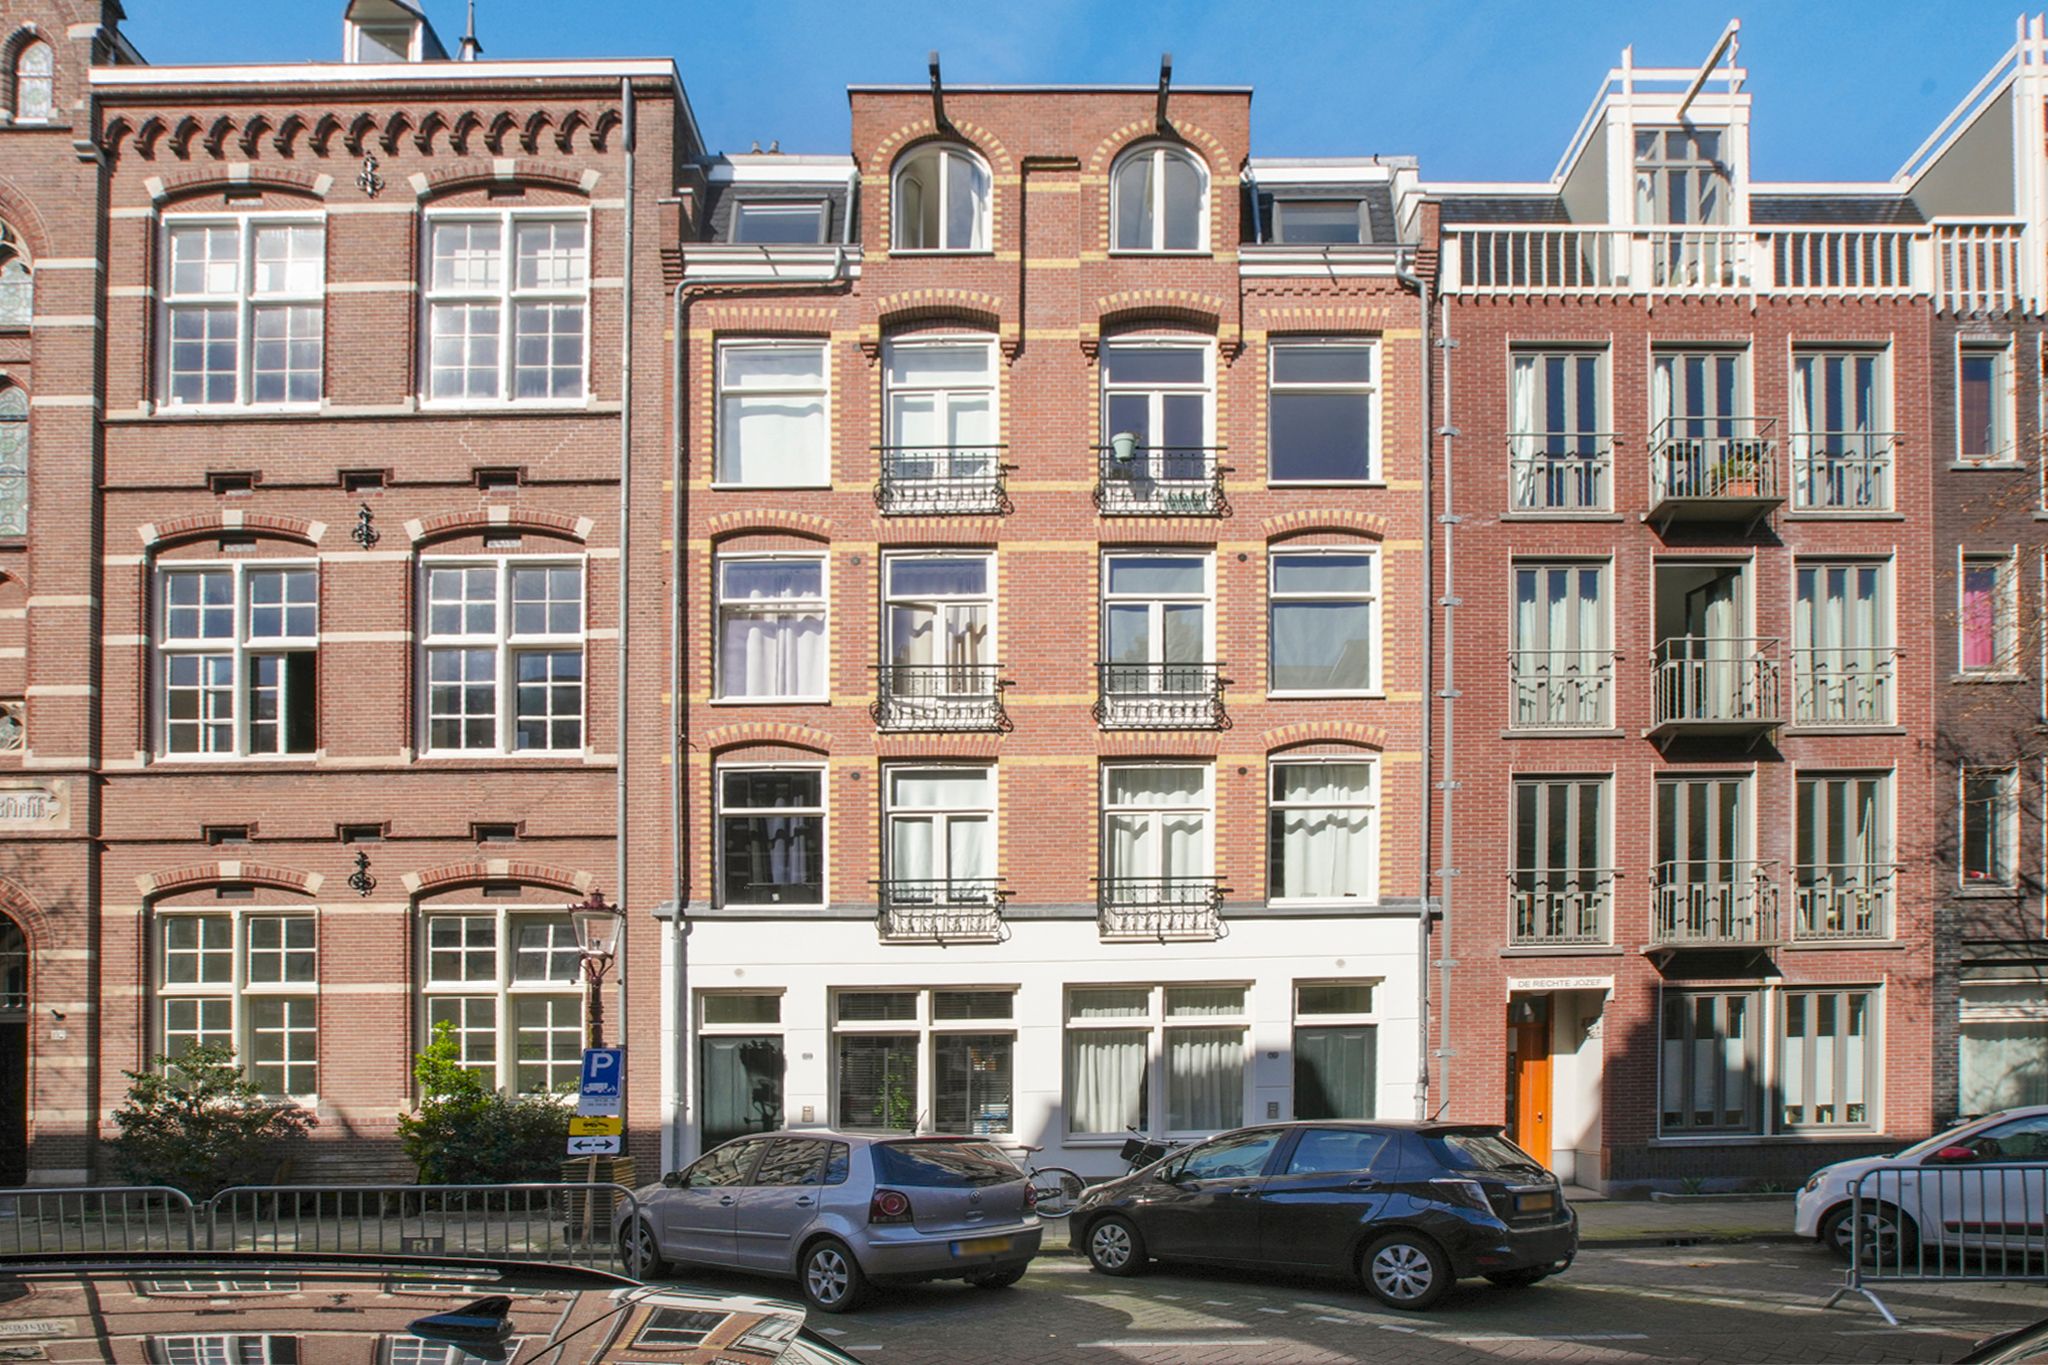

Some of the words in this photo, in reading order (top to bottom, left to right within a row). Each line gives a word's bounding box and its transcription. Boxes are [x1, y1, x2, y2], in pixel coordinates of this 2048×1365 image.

[1518, 980, 1531, 988] DE
[1533, 979, 1571, 988] RECHTE
[1574, 978, 1602, 986] JOZEF
[590, 1052, 614, 1078] P
